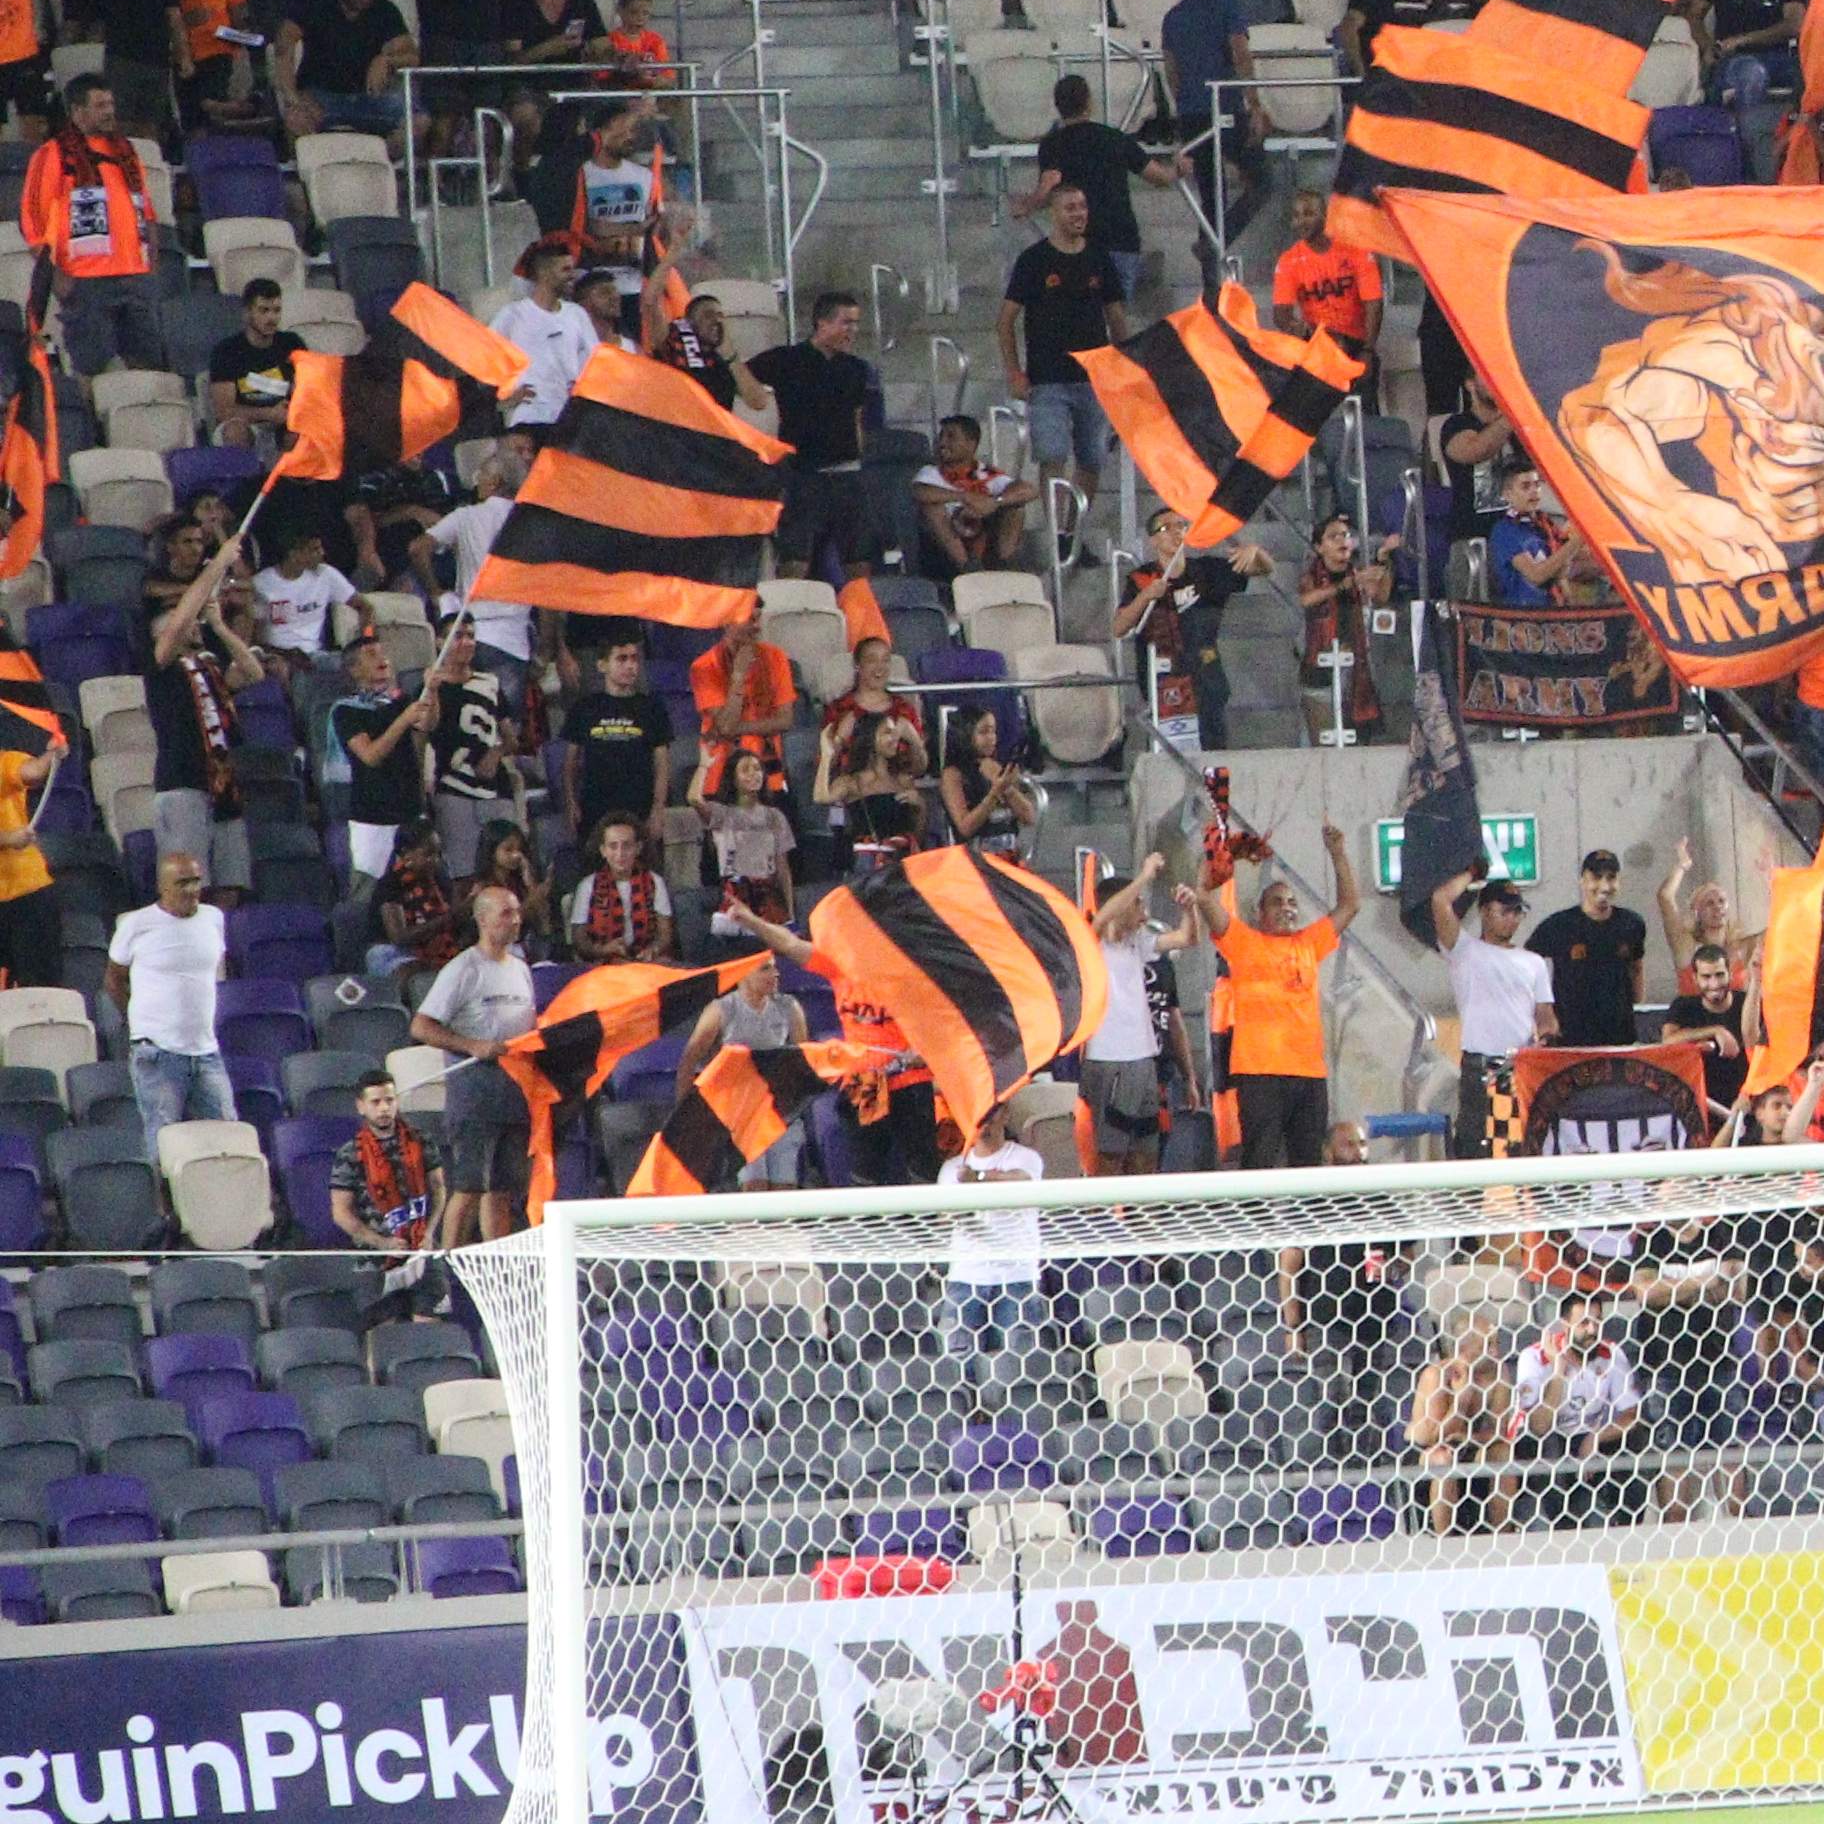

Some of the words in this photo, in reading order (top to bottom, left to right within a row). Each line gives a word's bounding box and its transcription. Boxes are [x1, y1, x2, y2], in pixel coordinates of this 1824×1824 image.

[597, 203, 641, 217] MIAMI
[1465, 619, 1607, 654] LIONS
[1465, 670, 1609, 717] ARMY
[1369, 1755, 1625, 1801] אלכוהול
